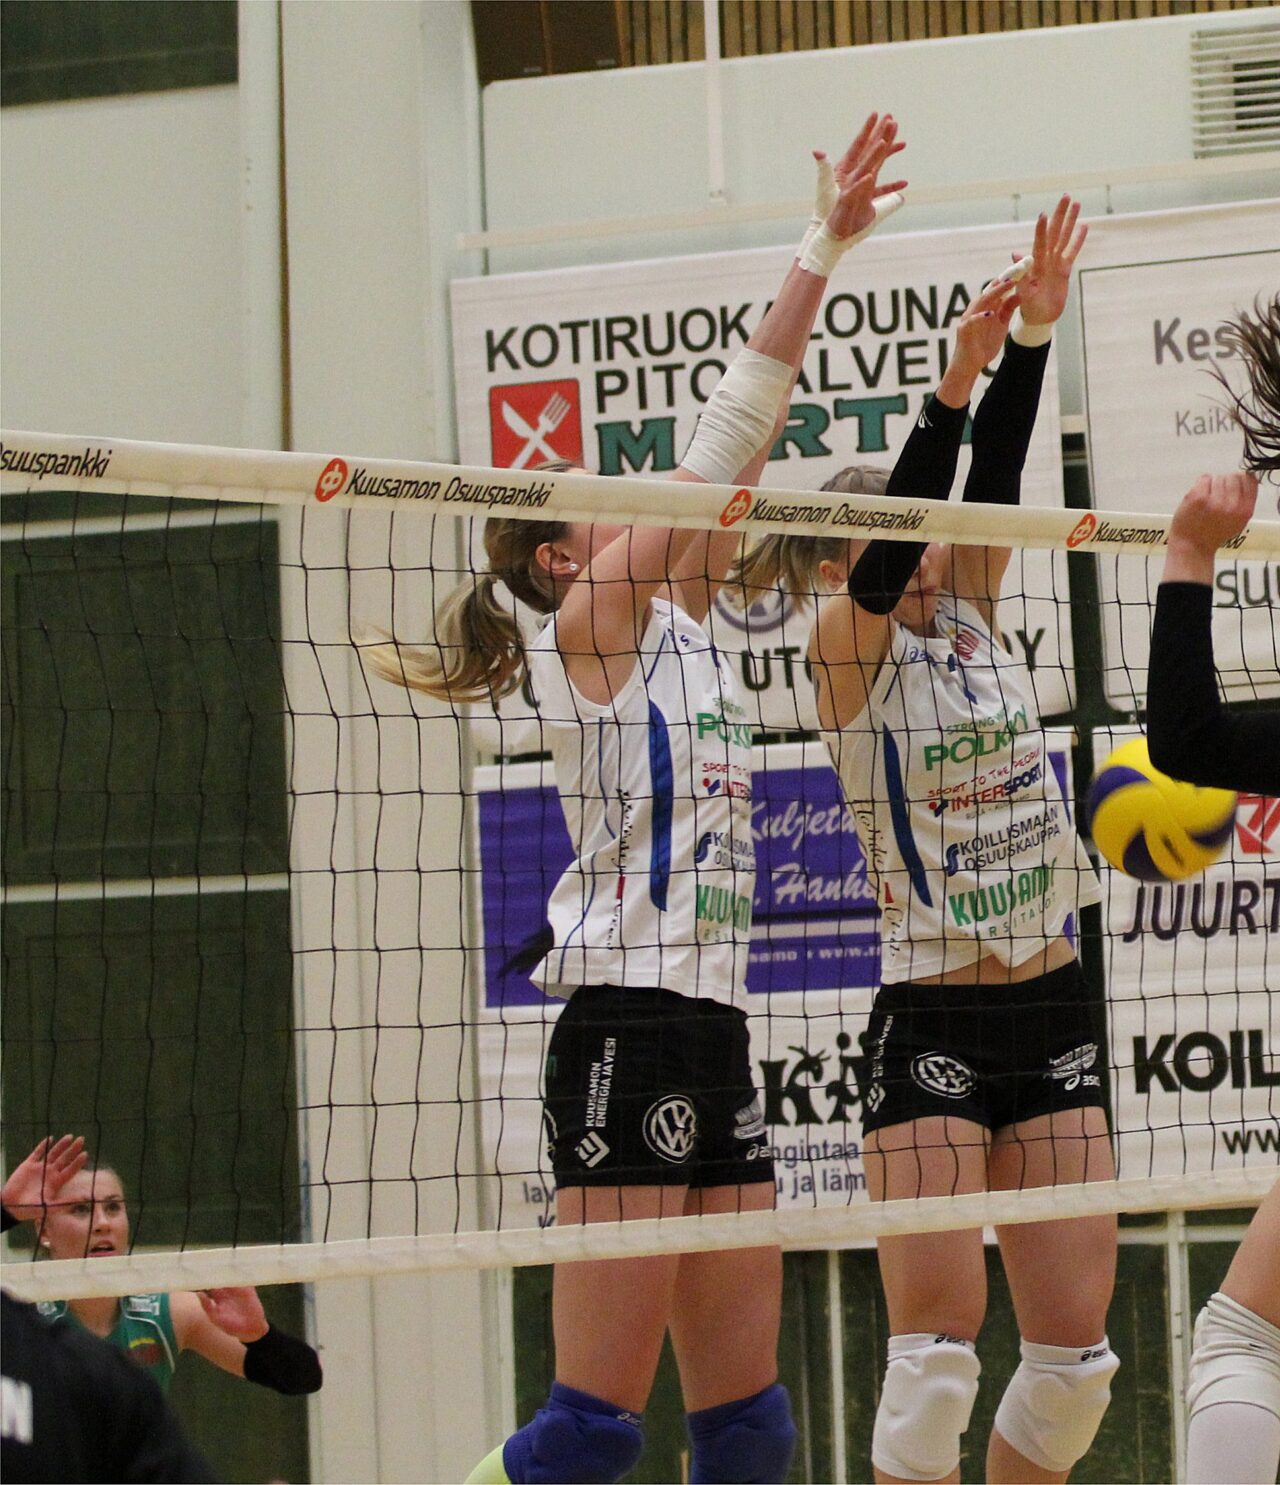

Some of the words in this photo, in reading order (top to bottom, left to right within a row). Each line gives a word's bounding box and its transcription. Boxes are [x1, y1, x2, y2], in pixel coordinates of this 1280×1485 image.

[344, 468, 441, 500] Kuusamon
[443, 476, 554, 509] Osuuspankki
[747, 498, 830, 524] Kuusamon
[831, 502, 929, 531] Osuuspankki
[1091, 521, 1165, 545] Kuusamon
[951, 763, 1043, 813] INTERSPORT
[957, 804, 1059, 856] KOILLISMAAN
[963, 823, 1061, 871] OSUUSKAUPPA
[595, 1077, 611, 1128] ENERGIA
